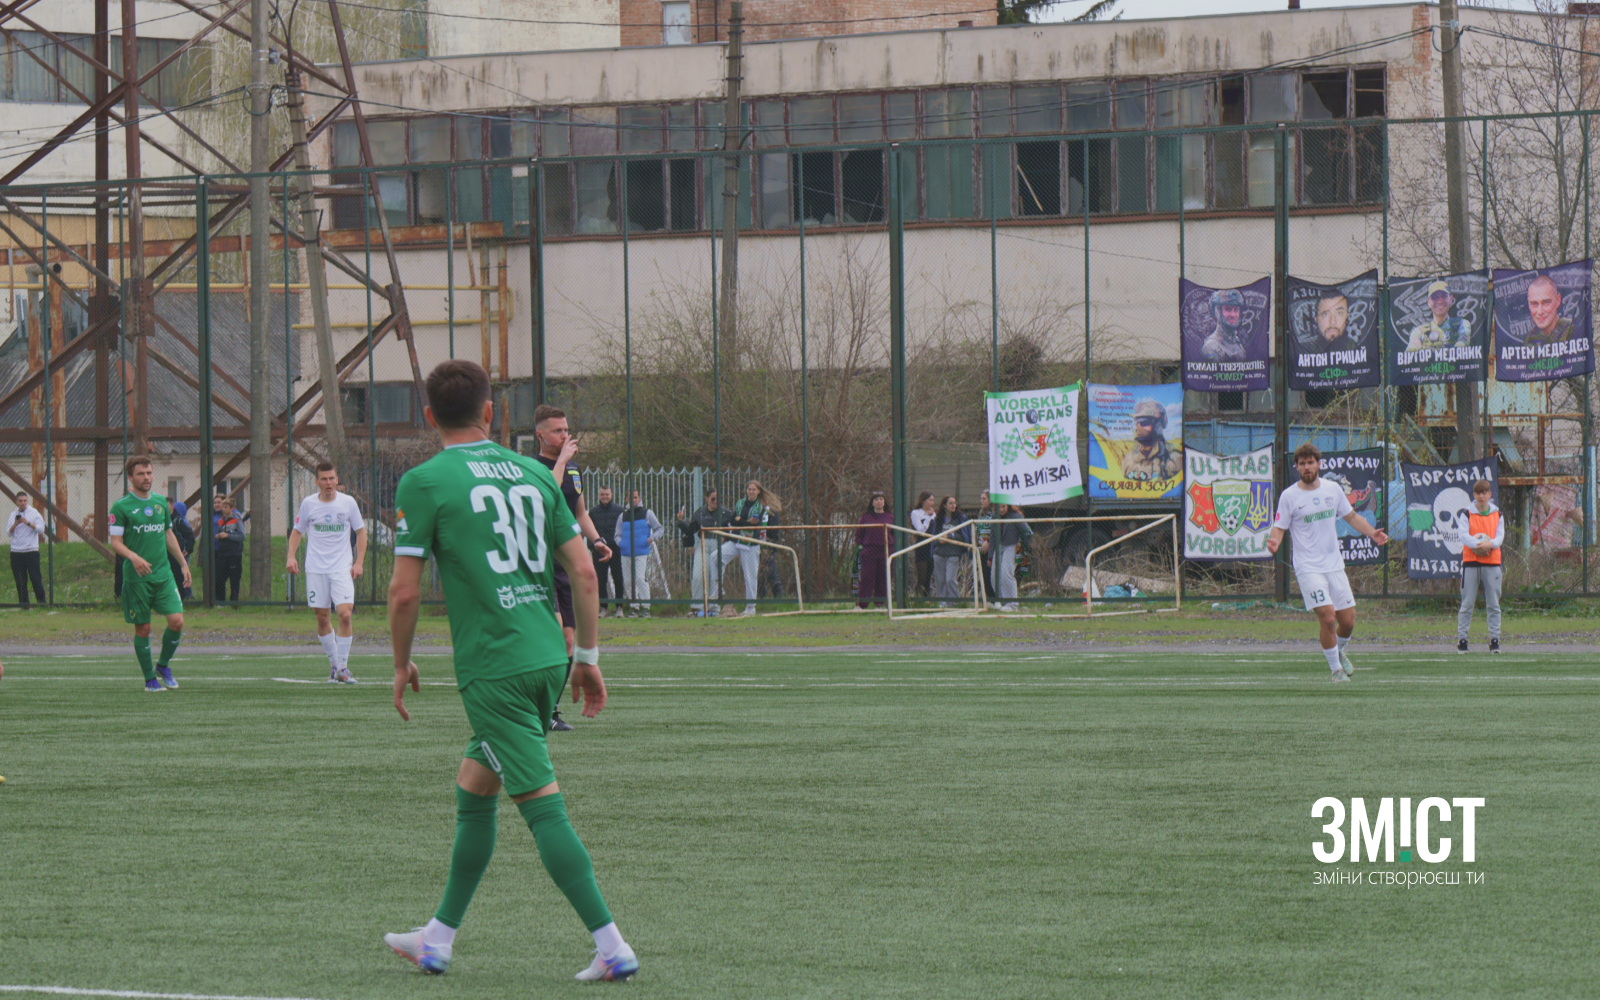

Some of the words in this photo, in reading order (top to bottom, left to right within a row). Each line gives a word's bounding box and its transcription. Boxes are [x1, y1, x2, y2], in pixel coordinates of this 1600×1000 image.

[1298, 352, 1328, 367] АНТОН
[1330, 346, 1367, 365] ГРИЦАЙ
[1397, 348, 1432, 365] ВІКТОР
[1434, 345, 1483, 362] МЕДЯНИК
[1501, 345, 1535, 360] АРТЕМ
[1187, 362, 1217, 371] РОМАН
[1219, 360, 1266, 372] ТВЕРДОХЛІБ
[1424, 362, 1456, 374] «МЕД»
[997, 393, 1070, 411] VORSKLA
[466, 460, 524, 481] ШВЕЦЬ
[1190, 455, 1270, 476] ULTRAS
[1319, 456, 1380, 475] ВОРСКЛУ
[999, 473, 1021, 490] НА
[1098, 480, 1142, 491] СЛАВА
[1410, 466, 1493, 487] ВОРСКЛА
[470, 484, 548, 574] 30
[1410, 557, 1463, 575] НАЗАВ
[309, 590, 316, 604] 2
[1310, 589, 1325, 604] 43
